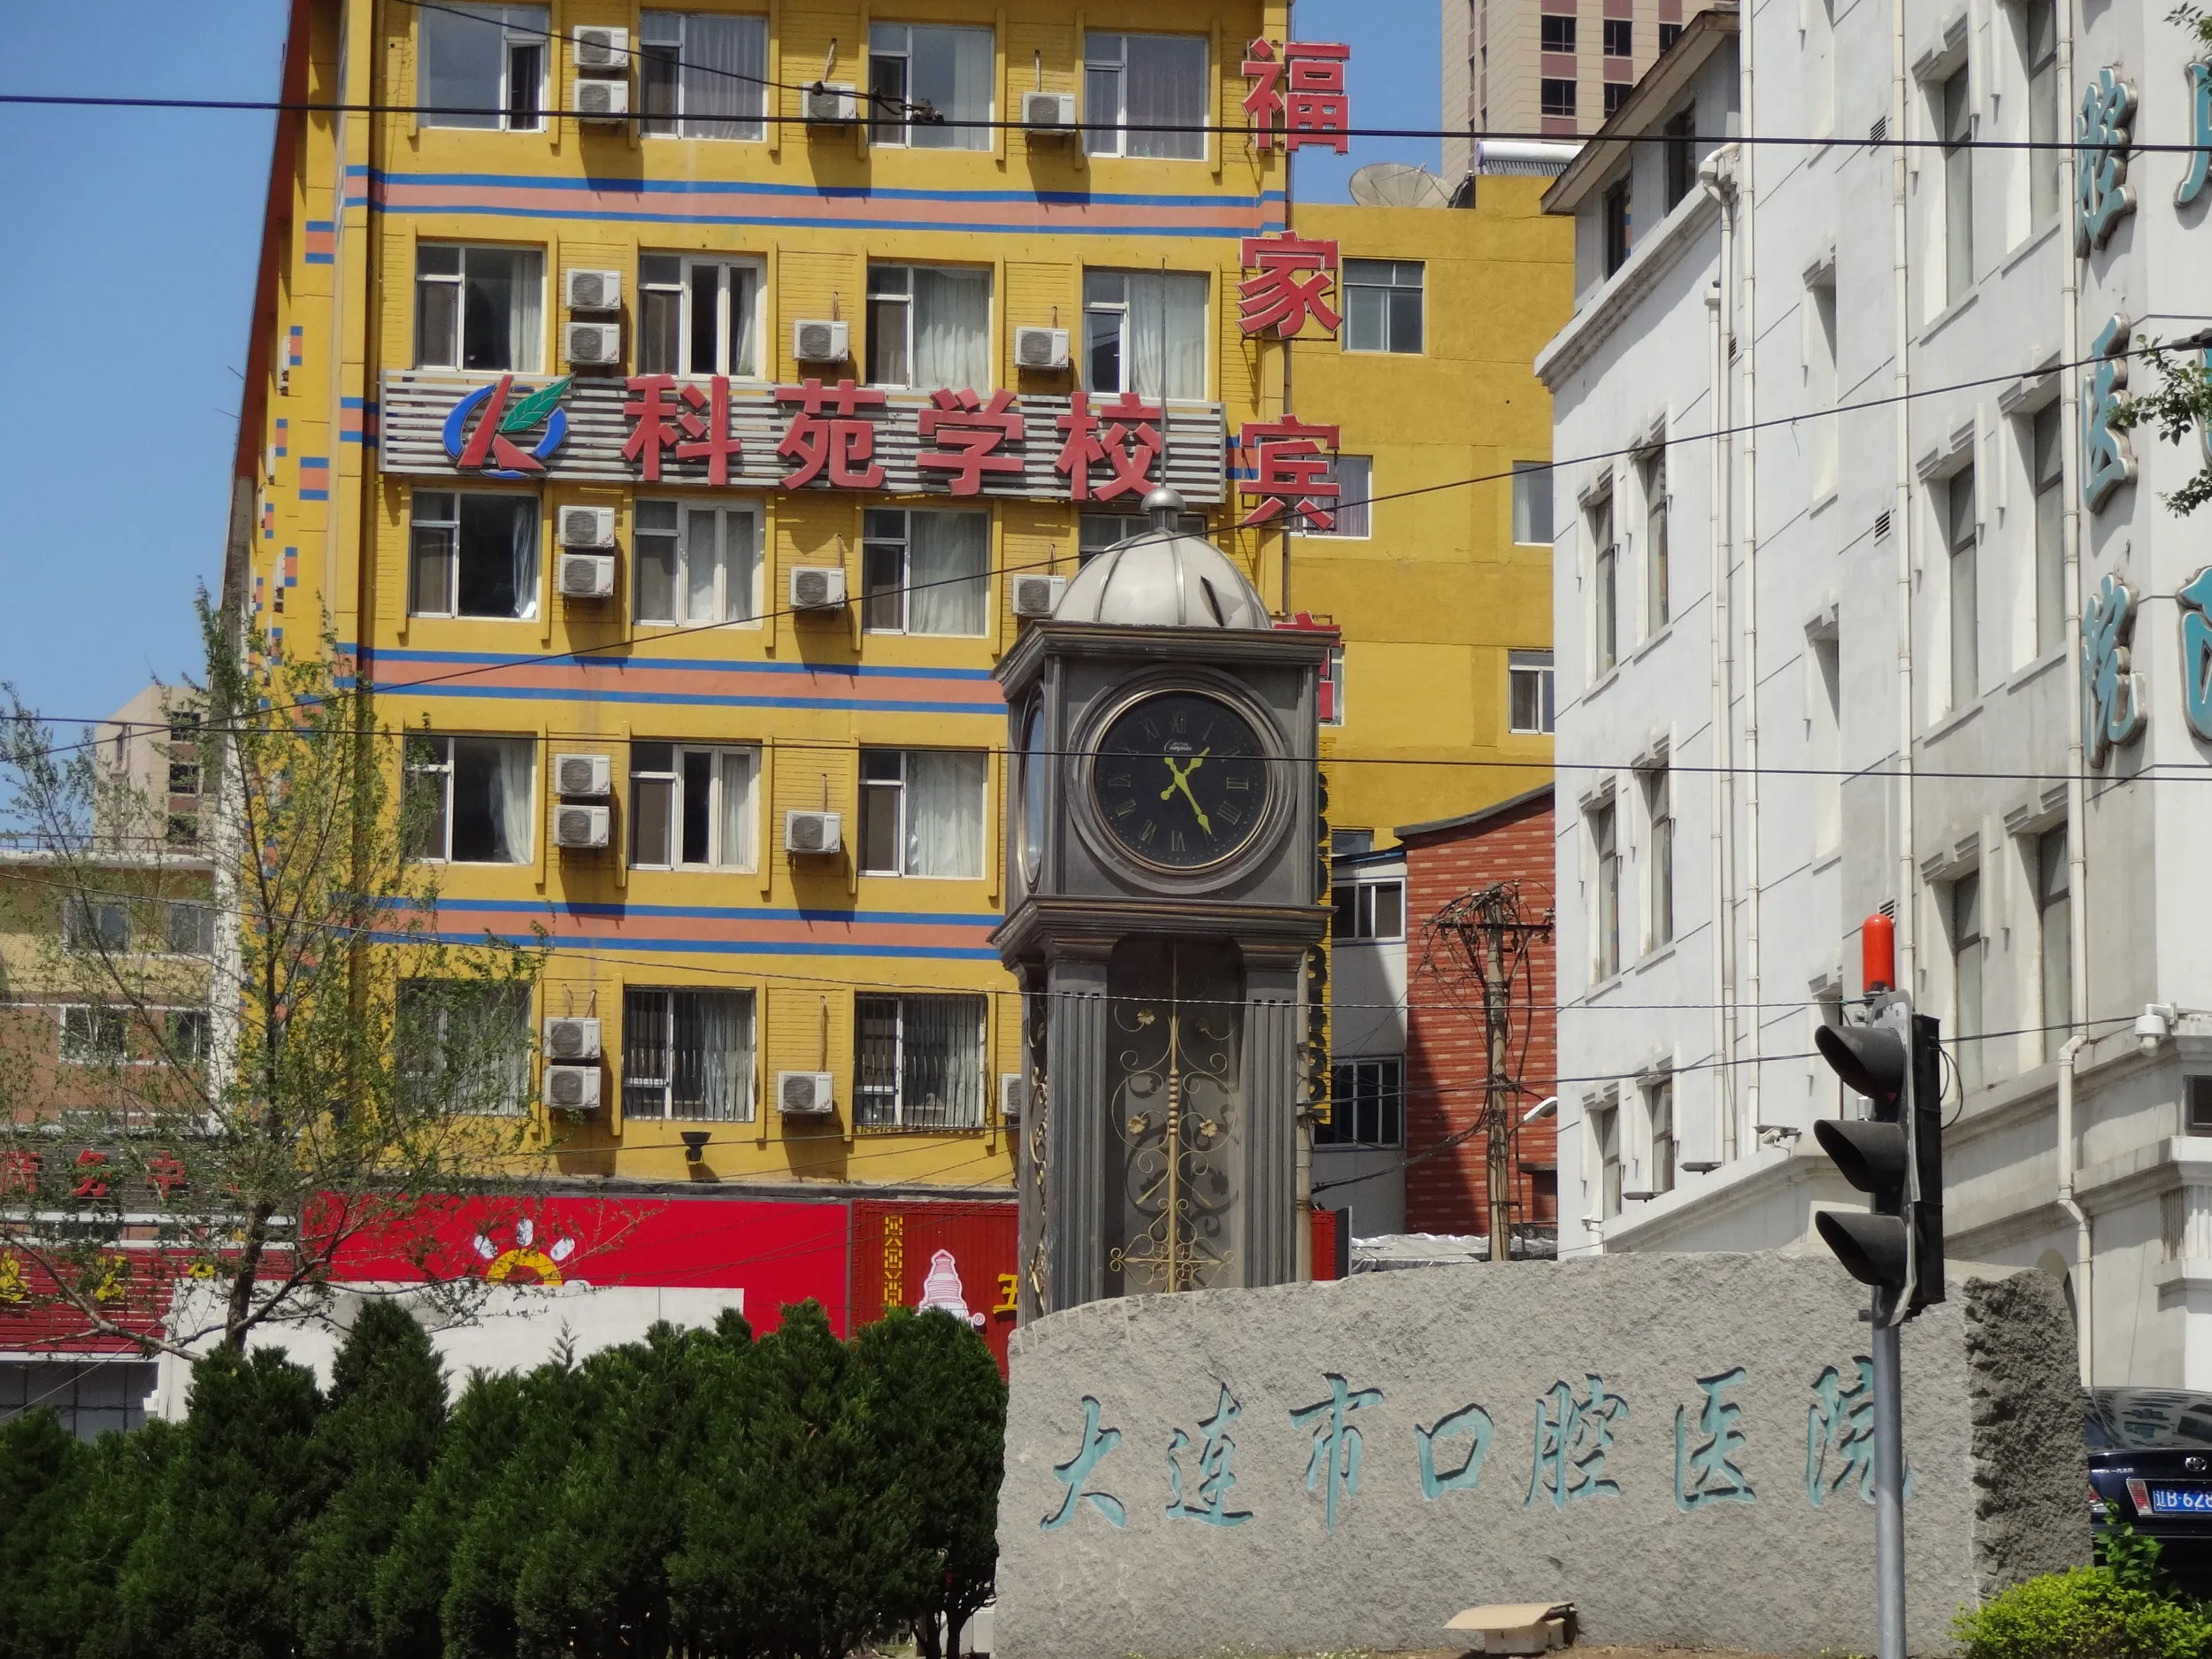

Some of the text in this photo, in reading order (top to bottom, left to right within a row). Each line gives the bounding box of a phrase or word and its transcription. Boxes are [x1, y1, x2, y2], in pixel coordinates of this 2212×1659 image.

[622, 373, 1166, 502] 科苑学校
[1040, 1355, 1915, 1536] 大连市口腔医院
